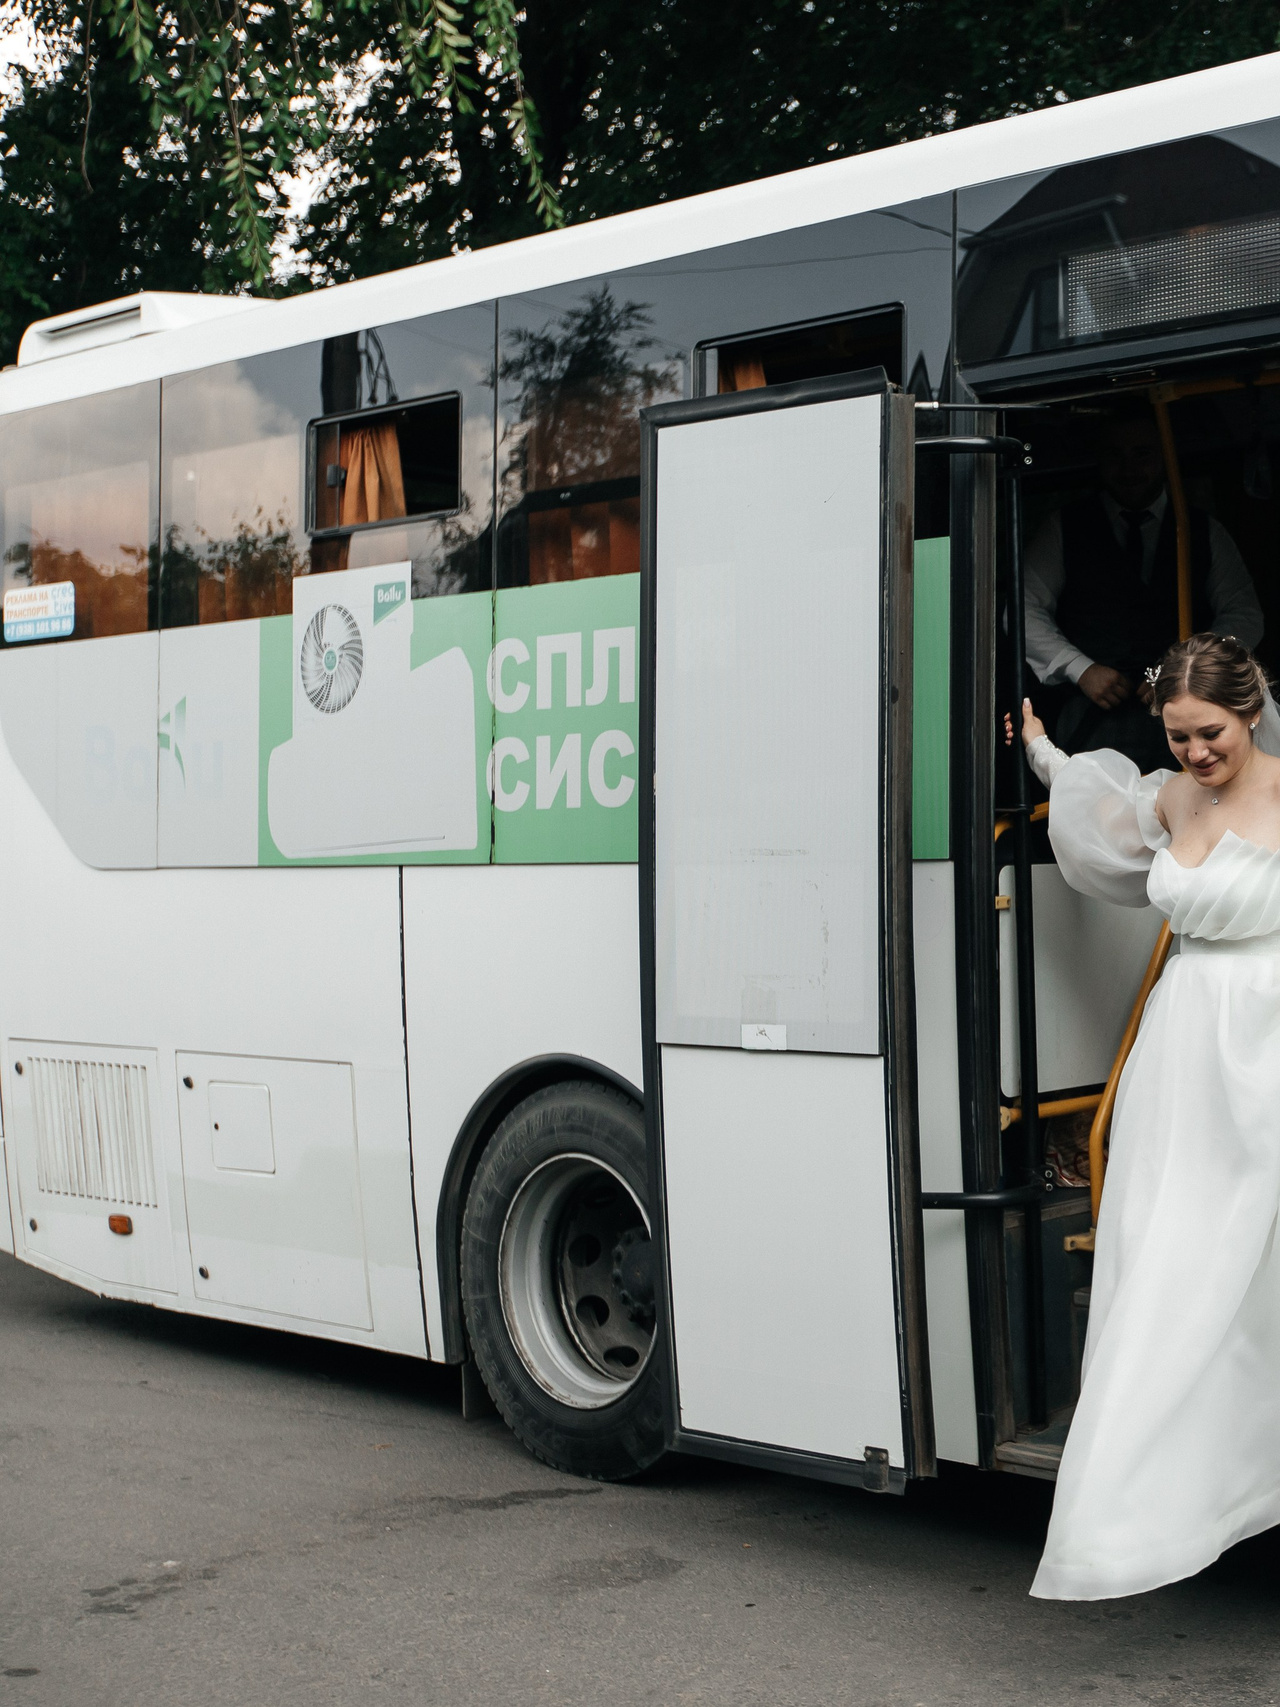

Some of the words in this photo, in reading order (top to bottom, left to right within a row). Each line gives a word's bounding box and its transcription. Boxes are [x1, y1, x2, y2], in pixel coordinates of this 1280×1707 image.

[6, 604, 49, 620] ТРАНСПОРТЕ
[377, 584, 402, 603] Ballu
[486, 625, 636, 714] СПЛ
[485, 729, 636, 813] СИС
